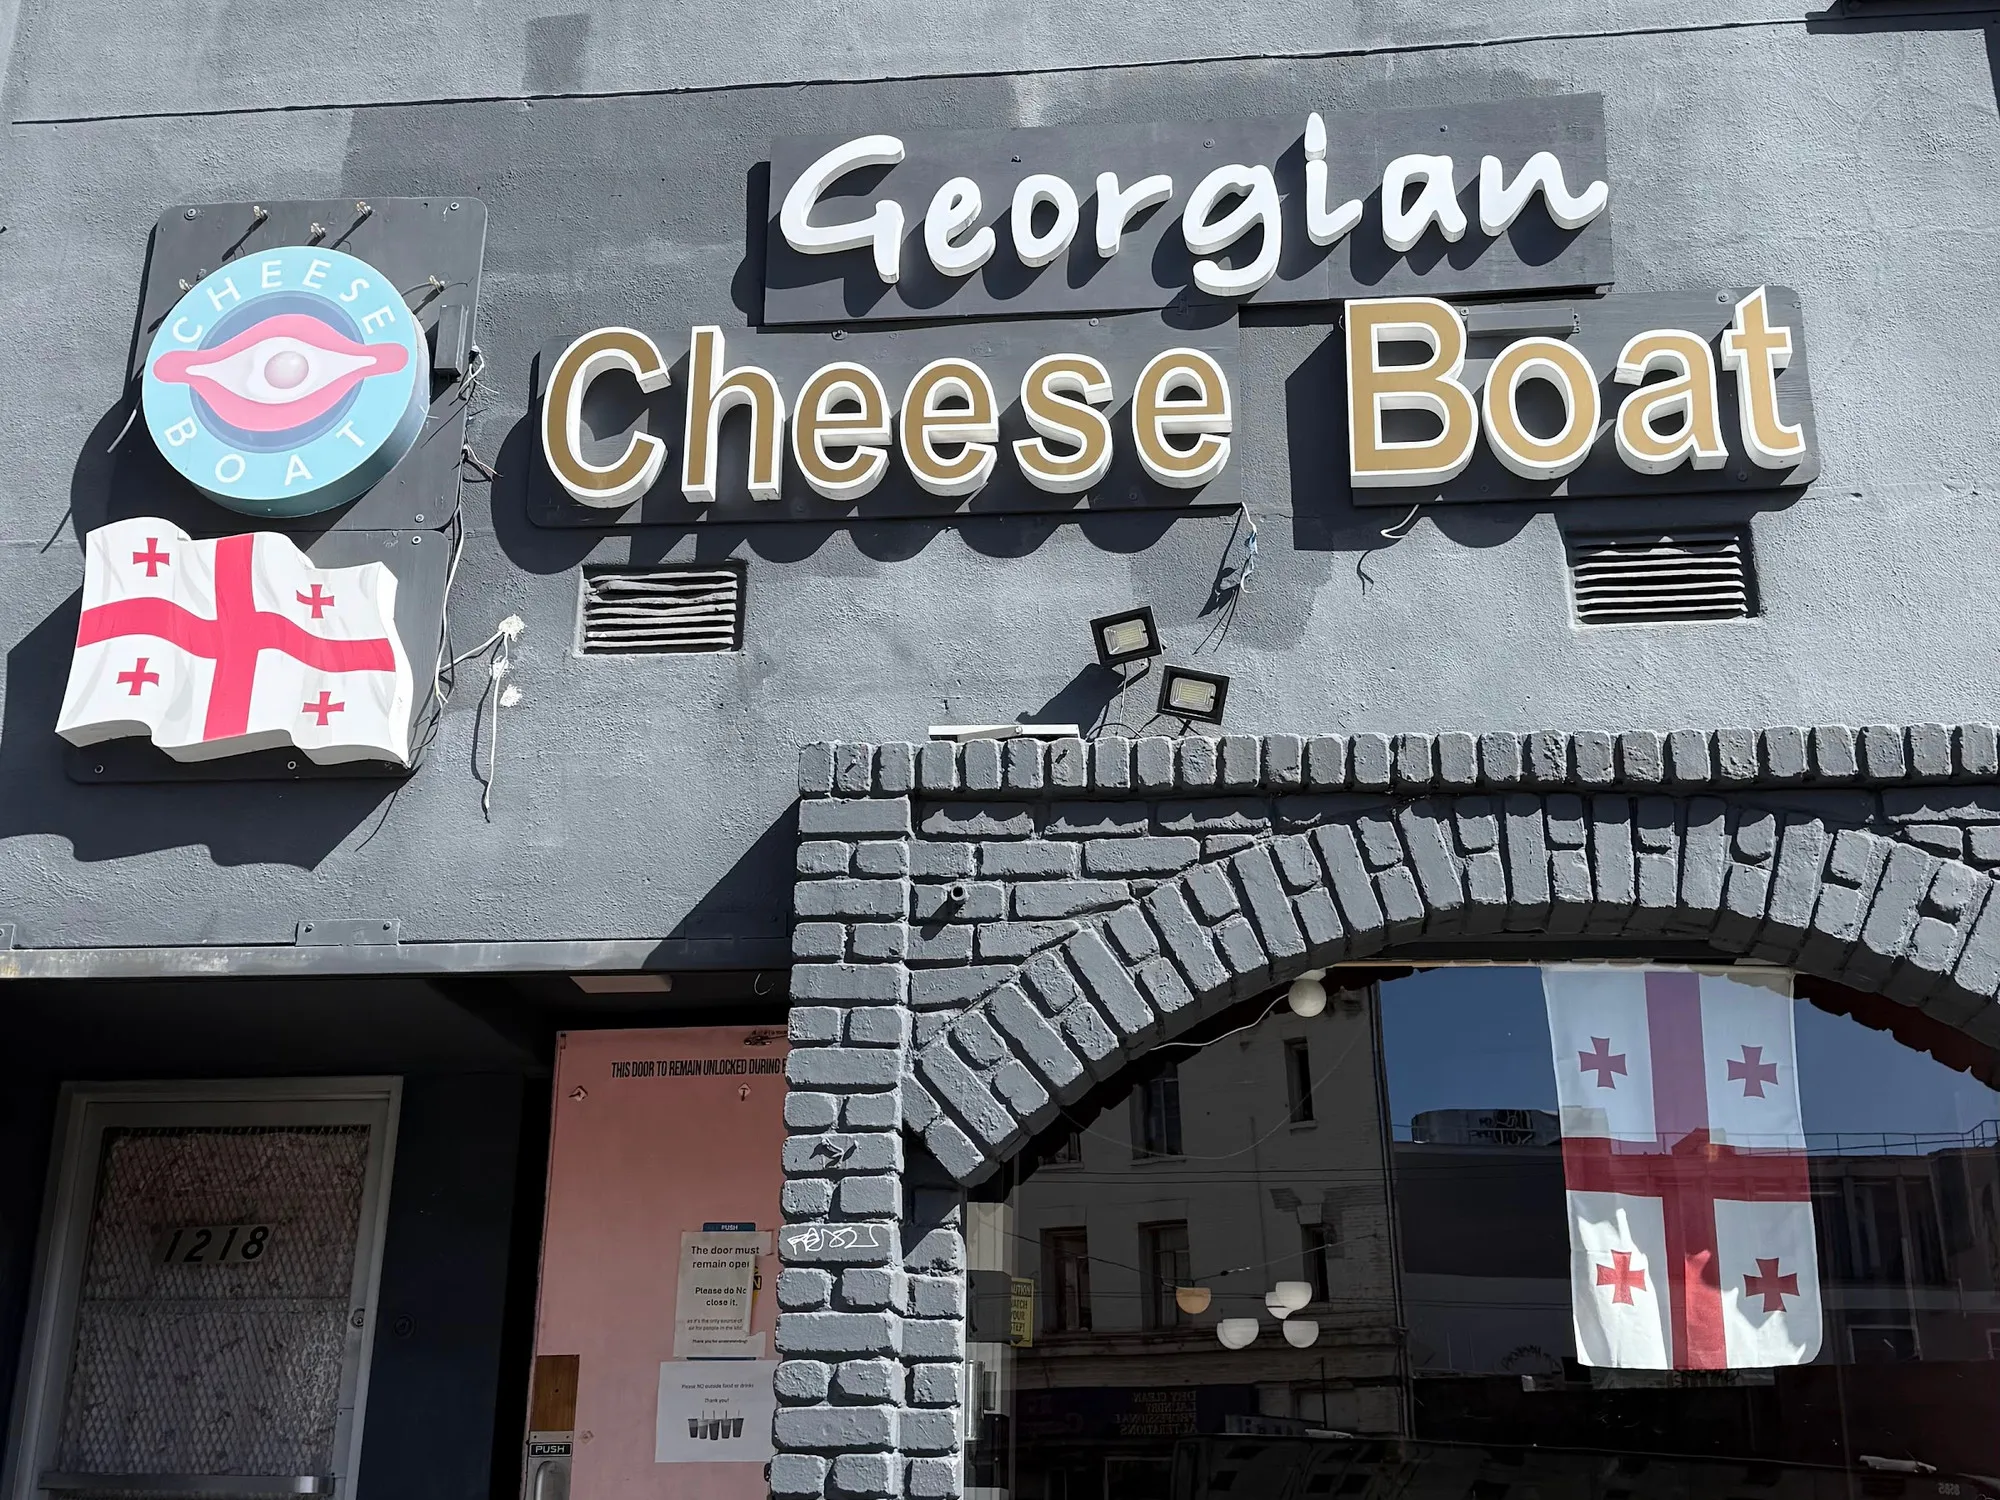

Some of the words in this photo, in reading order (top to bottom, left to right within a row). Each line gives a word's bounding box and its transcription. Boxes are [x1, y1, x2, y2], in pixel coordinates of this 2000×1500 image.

[780, 112, 1608, 296] Georgian
[172, 258, 396, 343] CHEESE
[541, 324, 1232, 509] Cheese
[1345, 284, 1806, 488] Boat
[164, 416, 366, 486] BOAT
[611, 1062, 631, 1078] THIS
[632, 1061, 655, 1077] DOOR
[657, 1060, 668, 1076] TO
[669, 1060, 702, 1076] REMAIN
[703, 1059, 747, 1075] UNLOCKED
[749, 1058, 781, 1074] DURING
[164, 1226, 269, 1262] 1218
[691, 1246, 708, 1255] The
[711, 1246, 733, 1255] door
[735, 1246, 760, 1255] must
[692, 1260, 726, 1269] remain
[695, 1286, 722, 1295] Please
[724, 1286, 735, 1295] do
[706, 1298, 728, 1307] close
[730, 1298, 738, 1307] it.
[535, 1445, 565, 1453] PUSH
